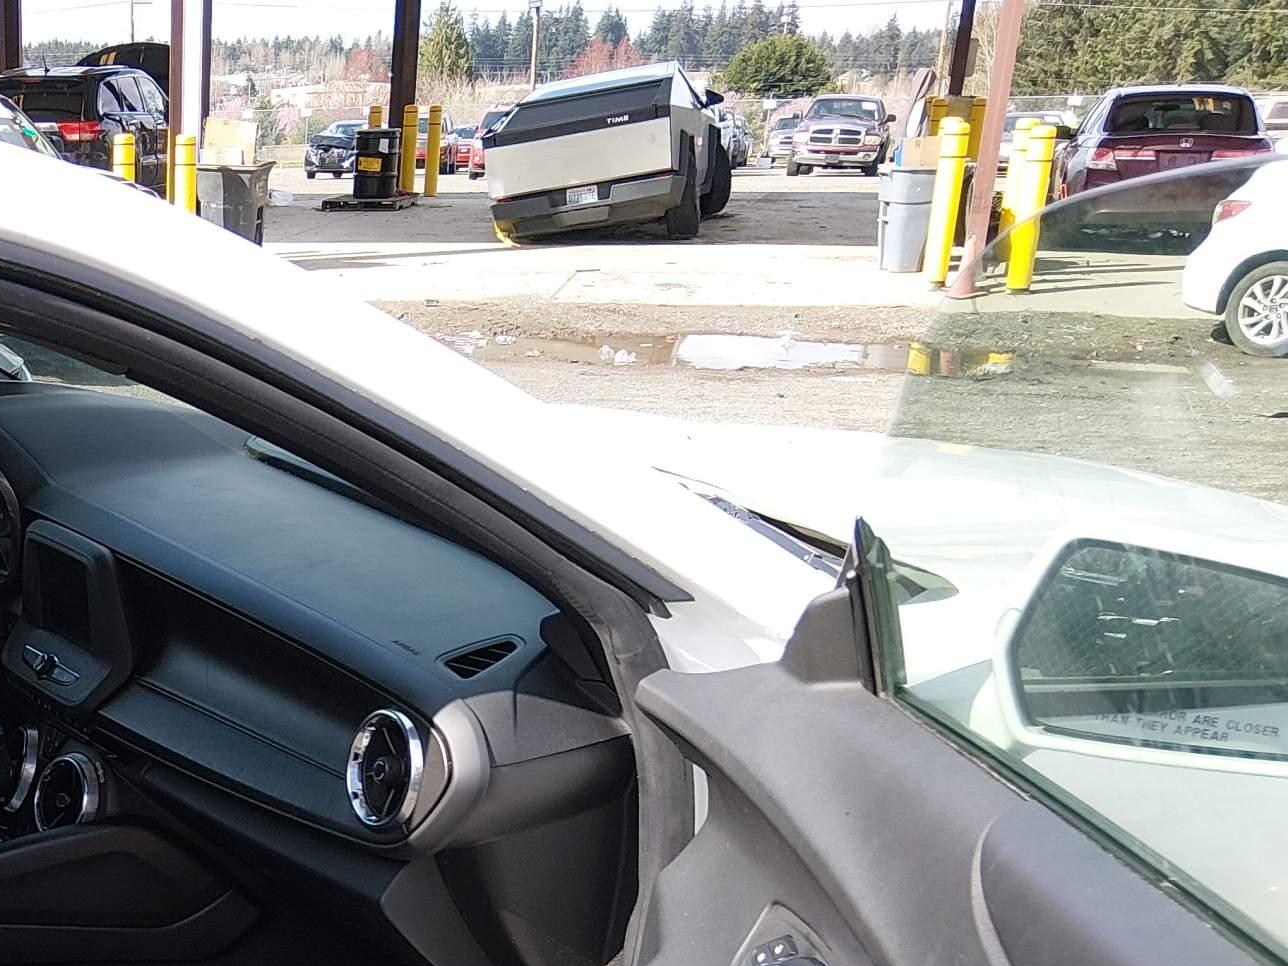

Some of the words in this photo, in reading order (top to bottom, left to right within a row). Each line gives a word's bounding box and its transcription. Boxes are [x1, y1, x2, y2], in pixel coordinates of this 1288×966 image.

[1096, 713, 1129, 725] THAN
[1136, 717, 1168, 732] THEY
[1173, 725, 1229, 742] APPEAR
[1193, 715, 1219, 728] ARE
[1225, 719, 1280, 737] CLOSER
